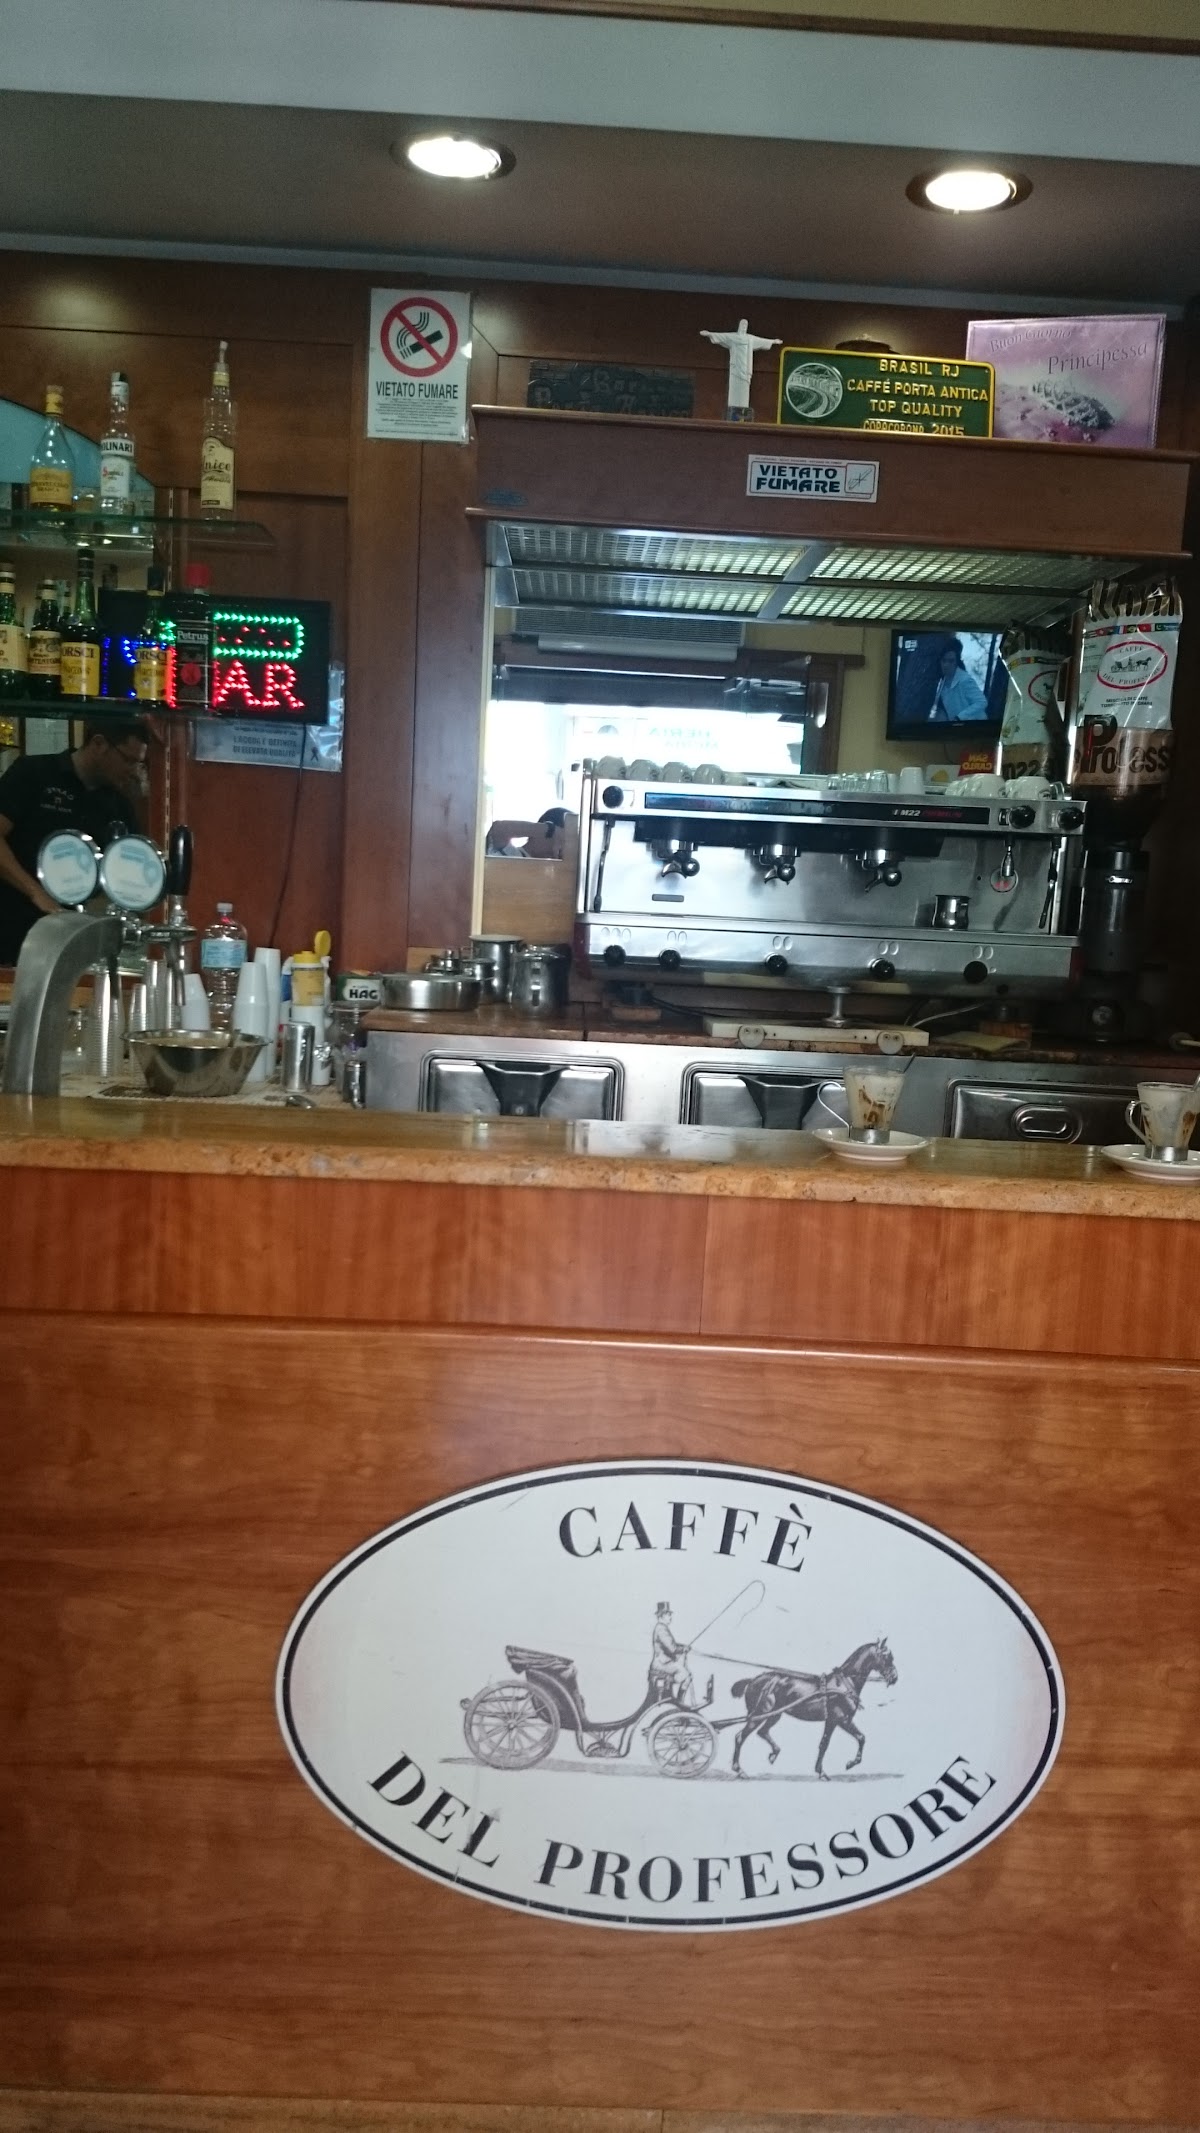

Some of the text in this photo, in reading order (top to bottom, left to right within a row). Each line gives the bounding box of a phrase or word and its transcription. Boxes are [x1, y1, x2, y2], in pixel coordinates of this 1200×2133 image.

[879, 358, 960, 377] BRASIL RJ
[1048, 342, 1148, 375] Principessa
[376, 381, 459, 399] VIETATO FUMARE
[894, 381, 936, 397] PORTA
[940, 385, 989, 401] ANTICA
[870, 399, 963, 418] TOP QUALITY
[931, 423, 965, 436] 2015
[101, 441, 133, 453] OLINARI
[759, 464, 838, 479] VIETATO
[756, 477, 841, 494] FUMARE
[349, 989, 378, 1000] HAG
[559, 1500, 812, 1573] CAFFÈ
[367, 1750, 998, 1903] DEL PROFESSORE
